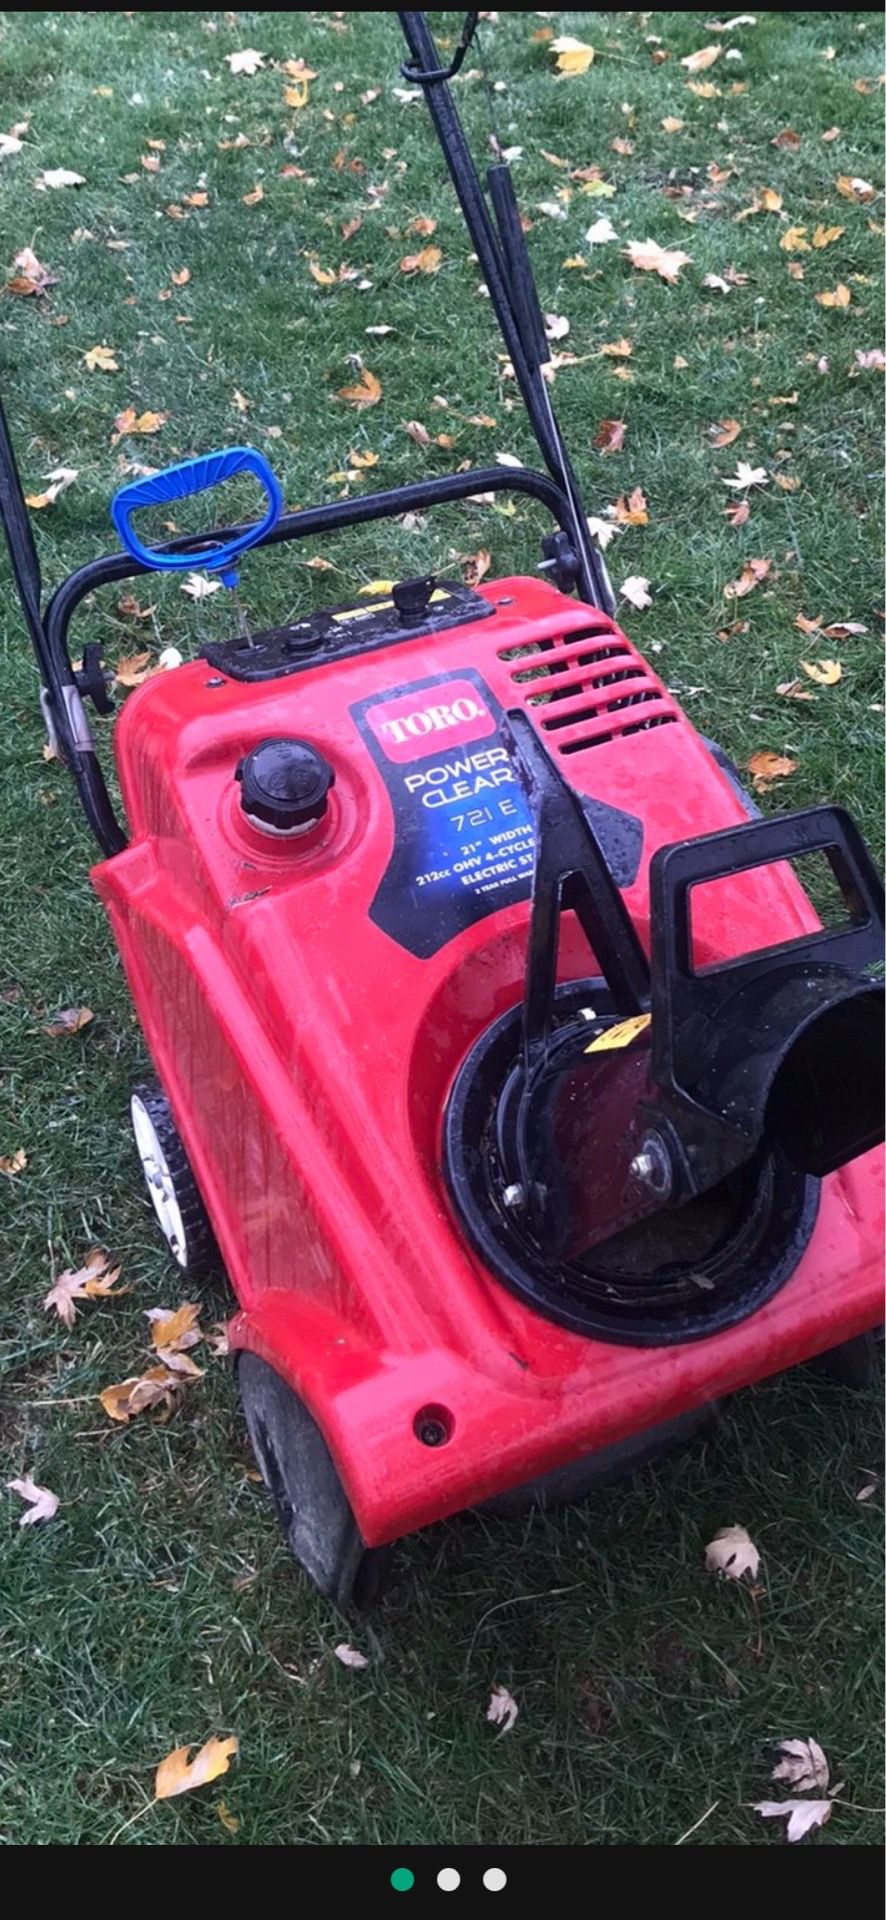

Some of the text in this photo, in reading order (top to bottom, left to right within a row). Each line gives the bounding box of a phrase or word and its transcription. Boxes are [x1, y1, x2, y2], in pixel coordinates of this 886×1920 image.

[404, 747, 510, 793] POWER
[422, 767, 516, 808] CLEAR
[450, 799, 518, 832] 721 E
[489, 824, 533, 845] WIDTH
[416, 837, 536, 886] 212cc OHV 4-CYCLE
[461, 852, 535, 886] ELECTRIC ST
